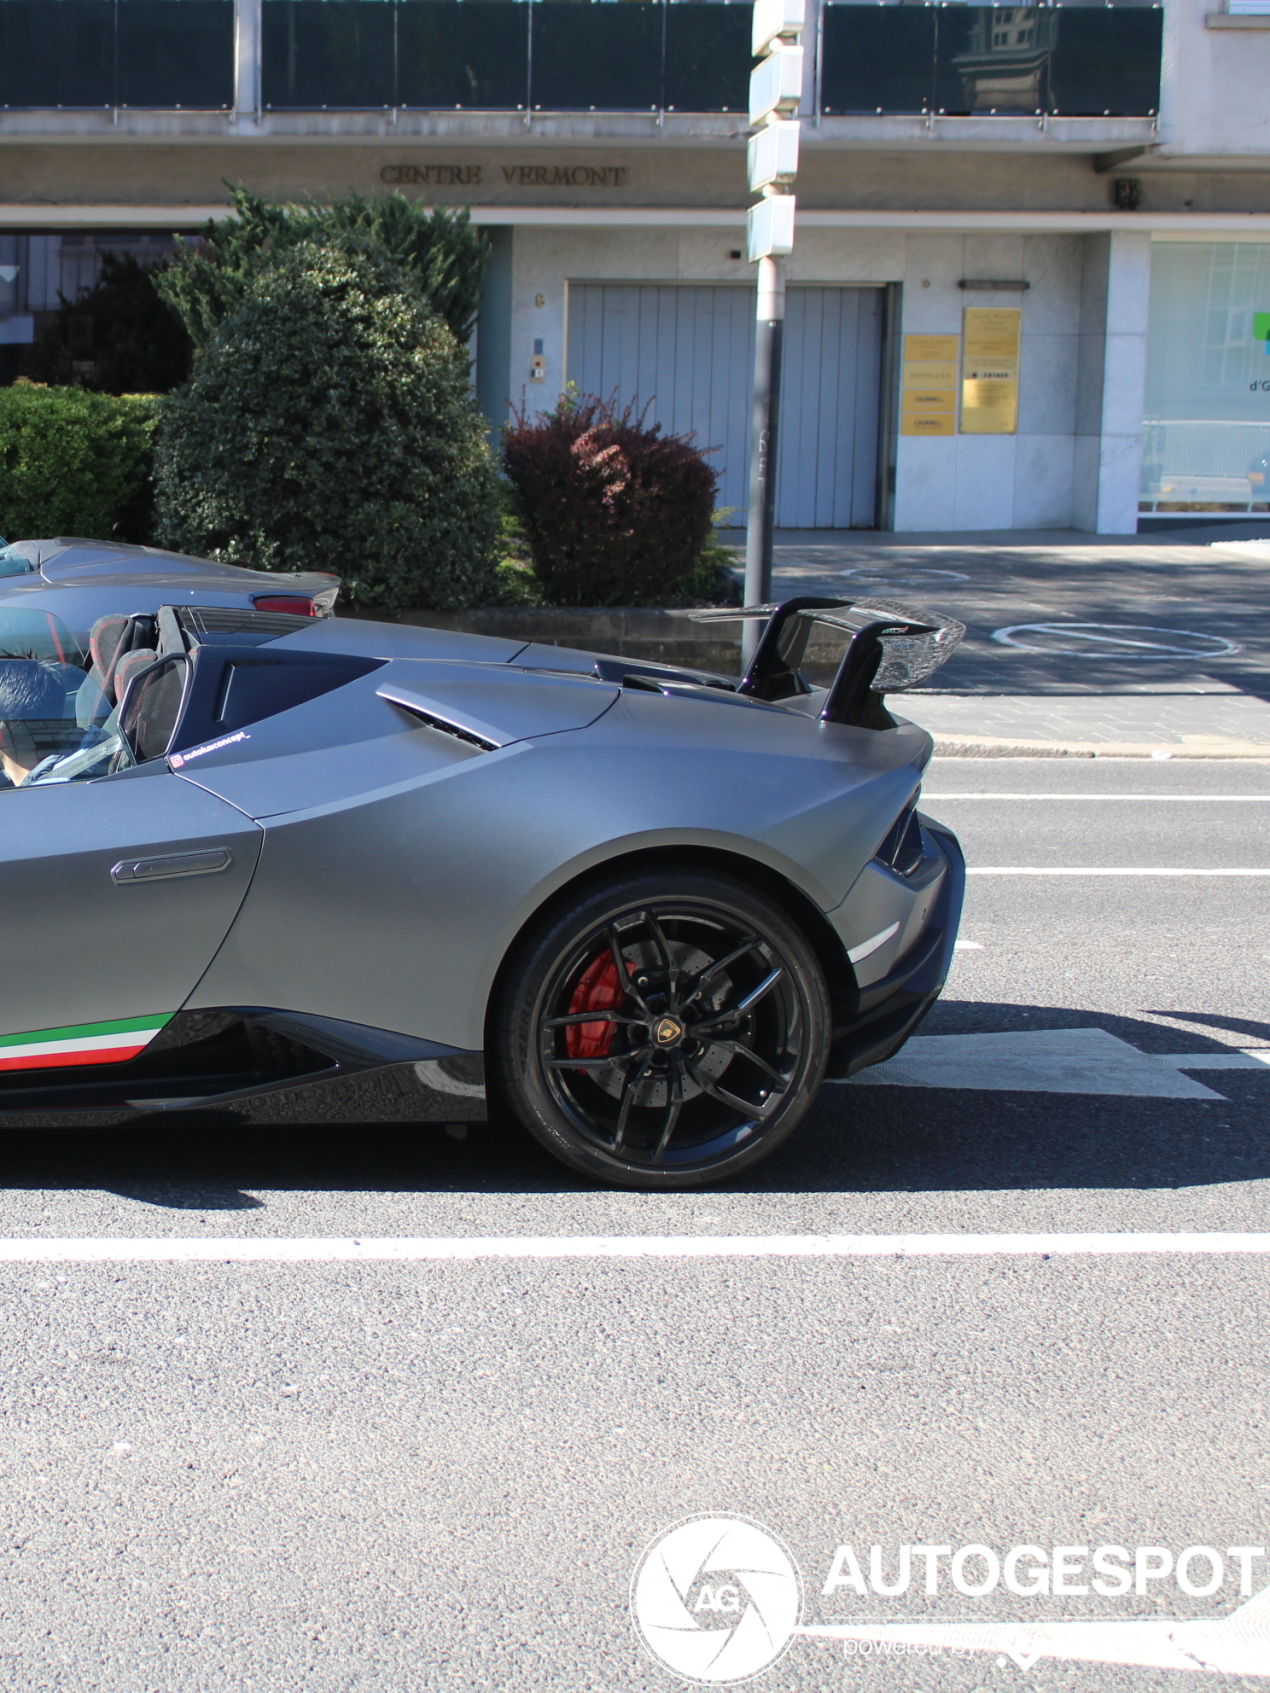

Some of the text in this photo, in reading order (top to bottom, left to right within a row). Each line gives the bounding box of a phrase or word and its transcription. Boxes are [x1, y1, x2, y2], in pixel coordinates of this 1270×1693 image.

[380, 165, 626, 187] CENTRE VERMONT
[183, 731, 251, 761] autoluxconcept_
